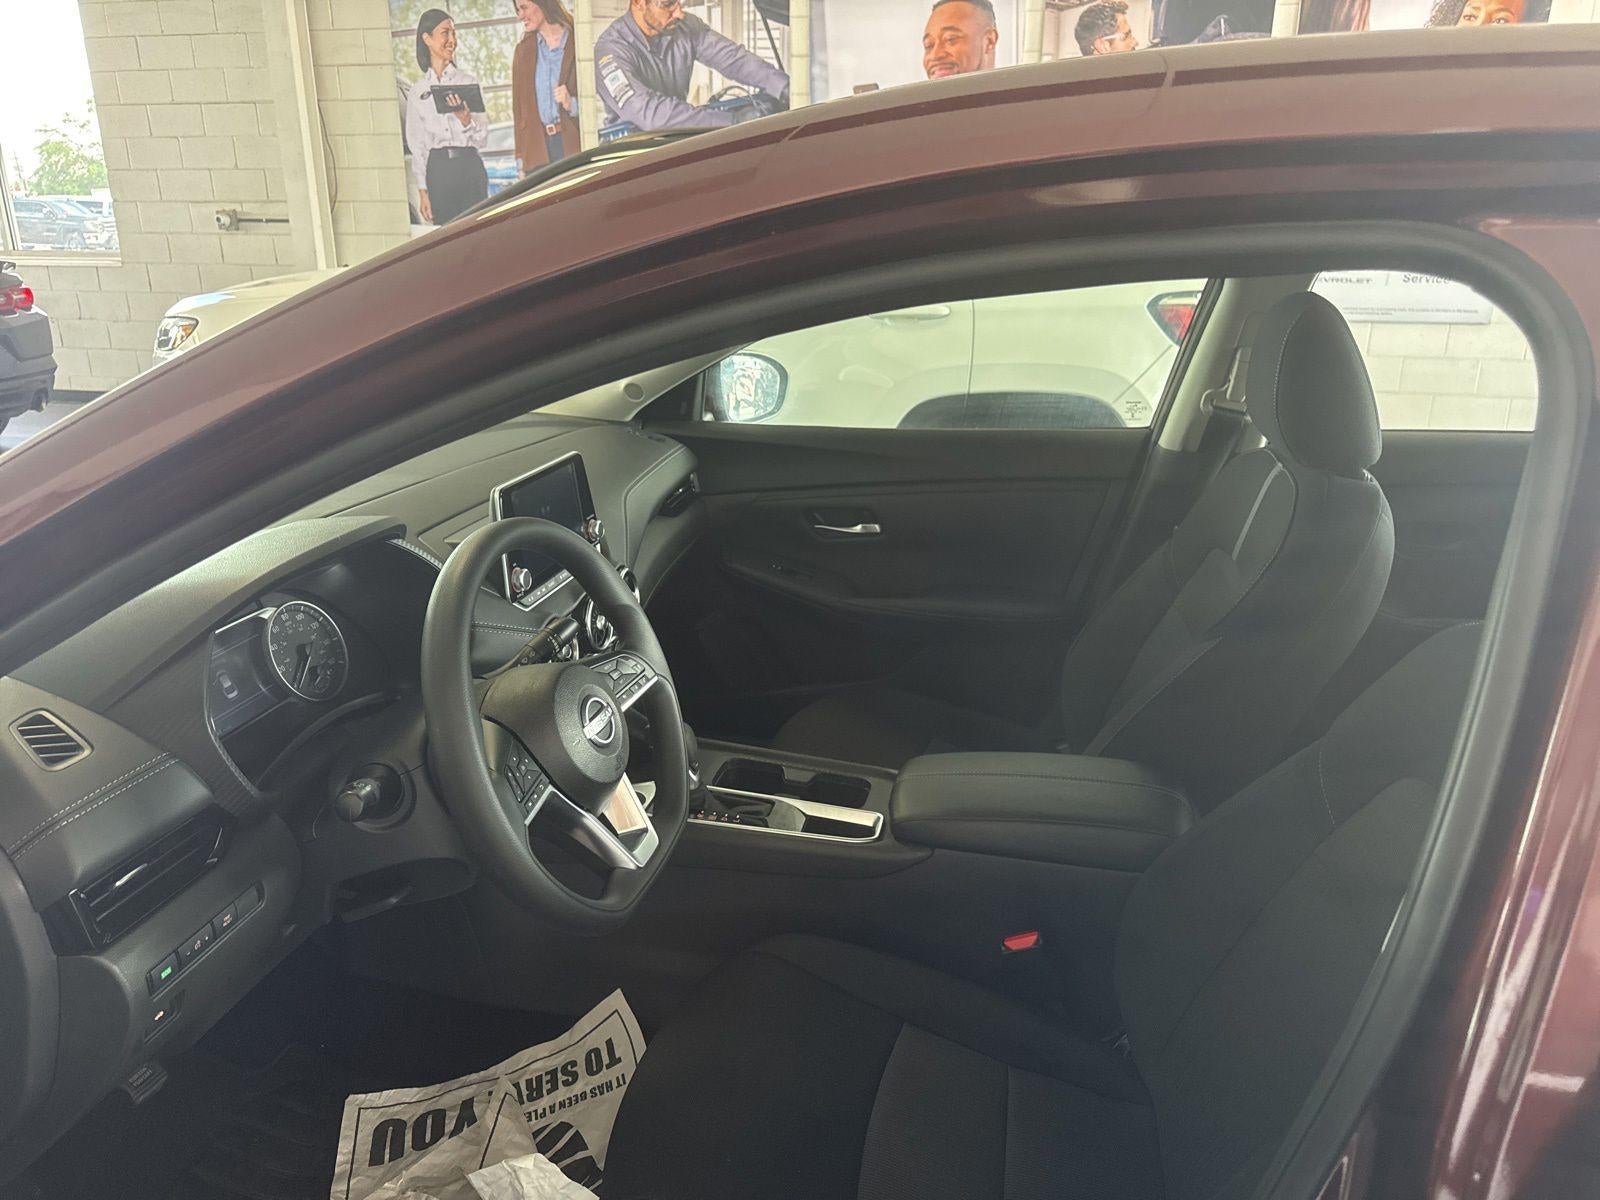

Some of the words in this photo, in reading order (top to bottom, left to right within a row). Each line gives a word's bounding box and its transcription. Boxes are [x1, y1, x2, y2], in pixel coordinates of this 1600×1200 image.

[584, 1036, 622, 1077] TO
[589, 1080, 614, 1099] HAS
[615, 1073, 627, 1089] IT
[548, 1103, 557, 1114] A
[558, 1090, 587, 1110] BEEN
[524, 1107, 547, 1123] PLE
[368, 1096, 478, 1168] YOU
